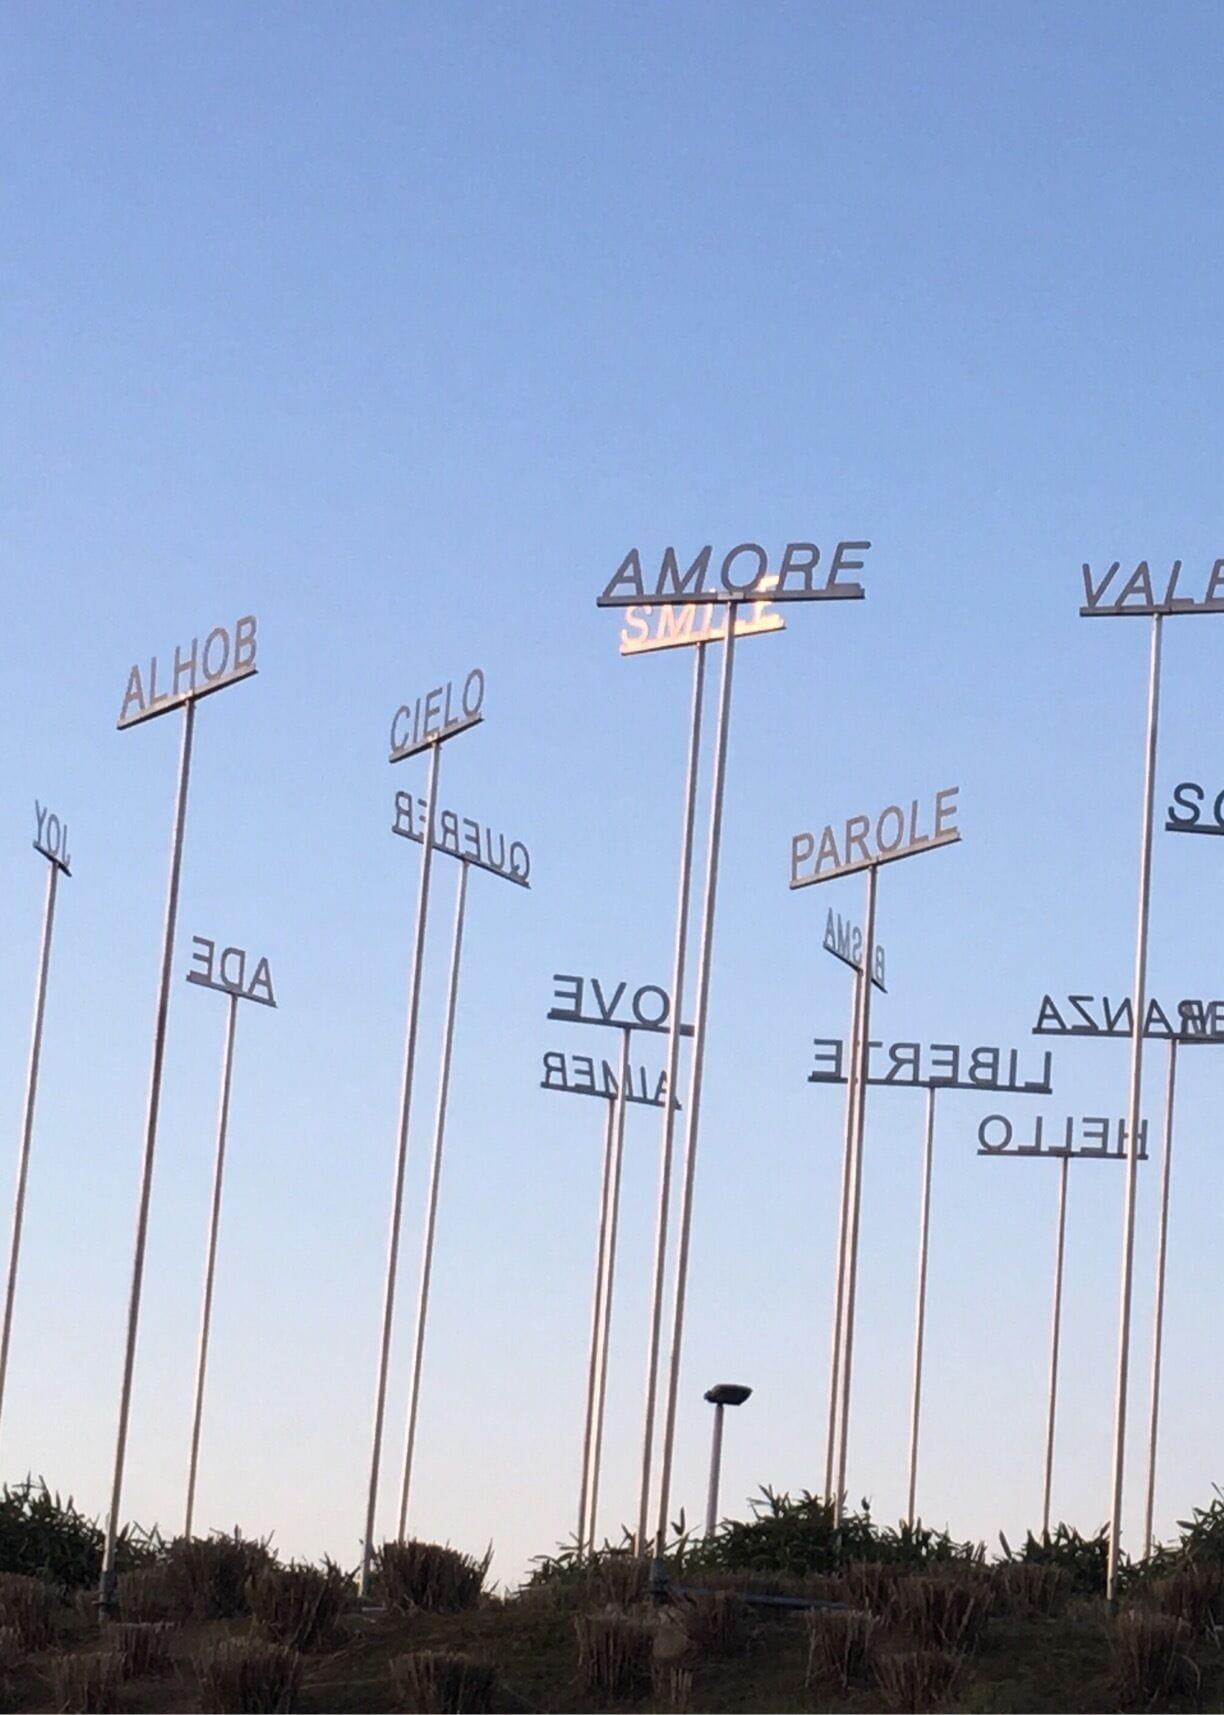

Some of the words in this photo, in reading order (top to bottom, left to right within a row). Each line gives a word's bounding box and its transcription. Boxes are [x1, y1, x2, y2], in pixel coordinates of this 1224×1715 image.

[601, 541, 872, 597] AMORE
[621, 575, 785, 646] SMIE
[119, 615, 257, 720] ALHOB
[390, 668, 484, 753] CIELO
[791, 786, 960, 880] PAROLE
